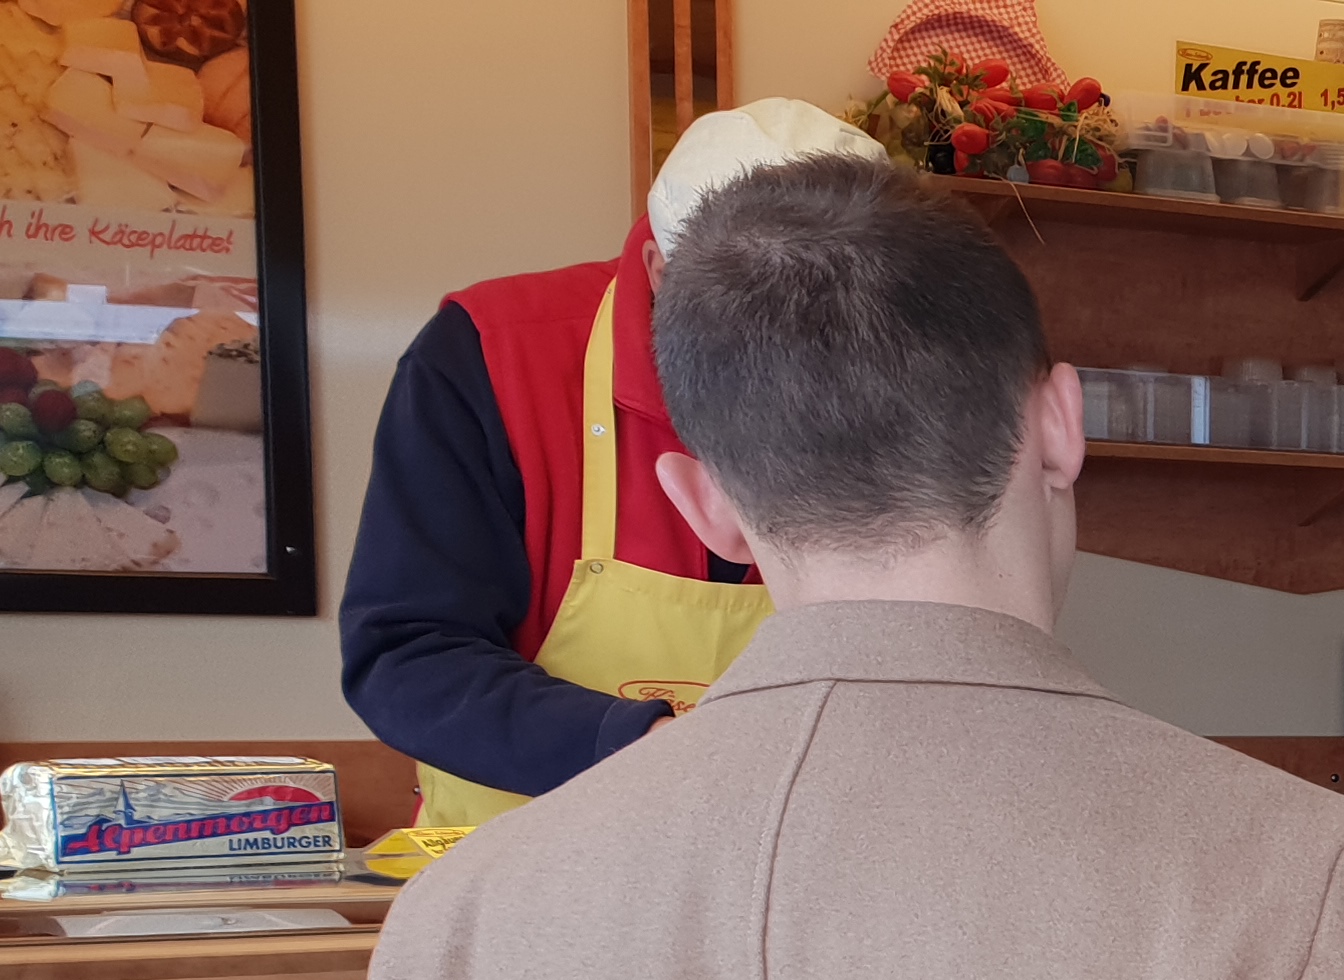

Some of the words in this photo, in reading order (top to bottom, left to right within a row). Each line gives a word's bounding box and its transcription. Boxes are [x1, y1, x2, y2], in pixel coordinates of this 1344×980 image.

[1181, 61, 1300, 92] Kaffee
[24, 208, 77, 243] ihre
[88, 217, 235, 260] Käseplatte!
[66, 802, 333, 855] Alpenmorgen
[228, 834, 333, 852] LIMBURGER
